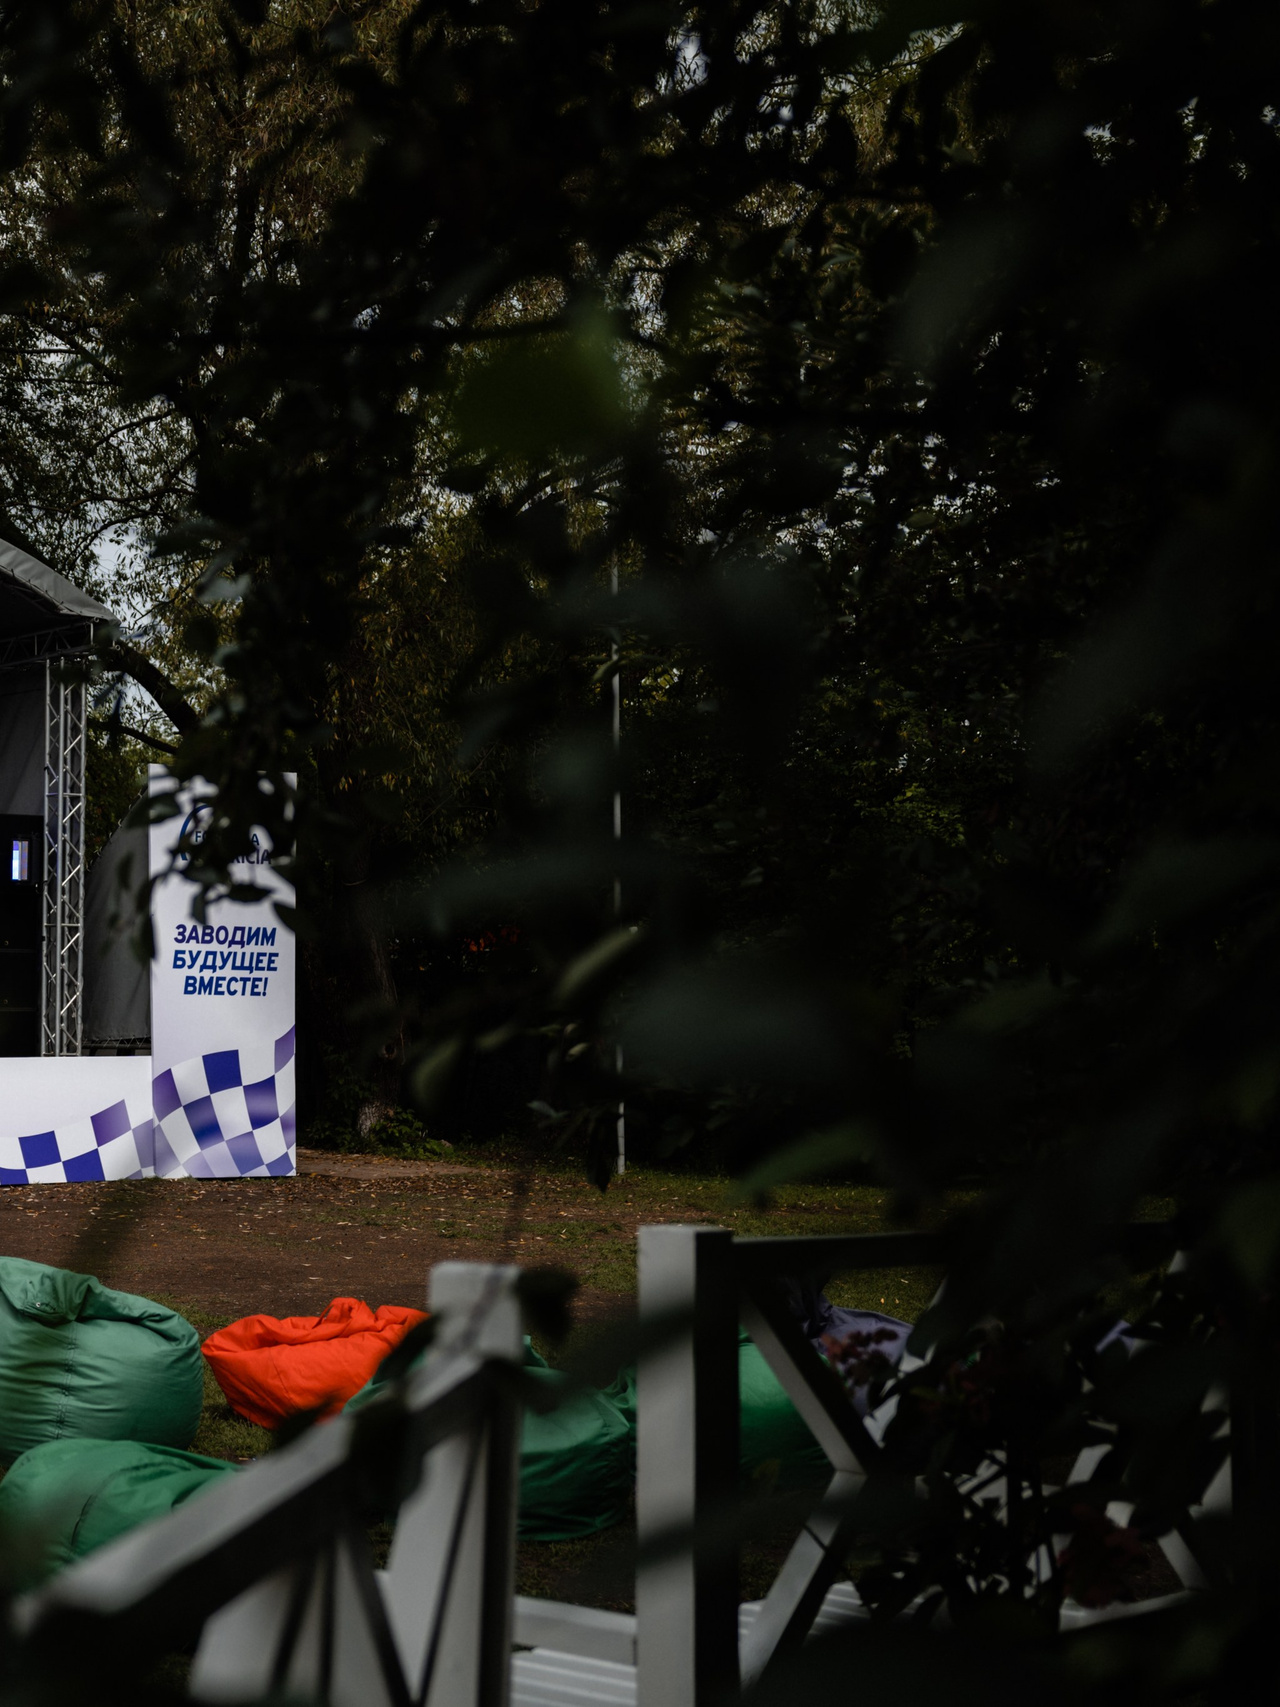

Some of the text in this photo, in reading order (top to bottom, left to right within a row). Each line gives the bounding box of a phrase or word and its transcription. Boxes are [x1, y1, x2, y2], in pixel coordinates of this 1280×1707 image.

[173, 923, 277, 949] ЗАВОДИМ
[172, 949, 279, 974] БУДУЩЕЕ
[183, 975, 269, 997] ВМЕСТЕ!
